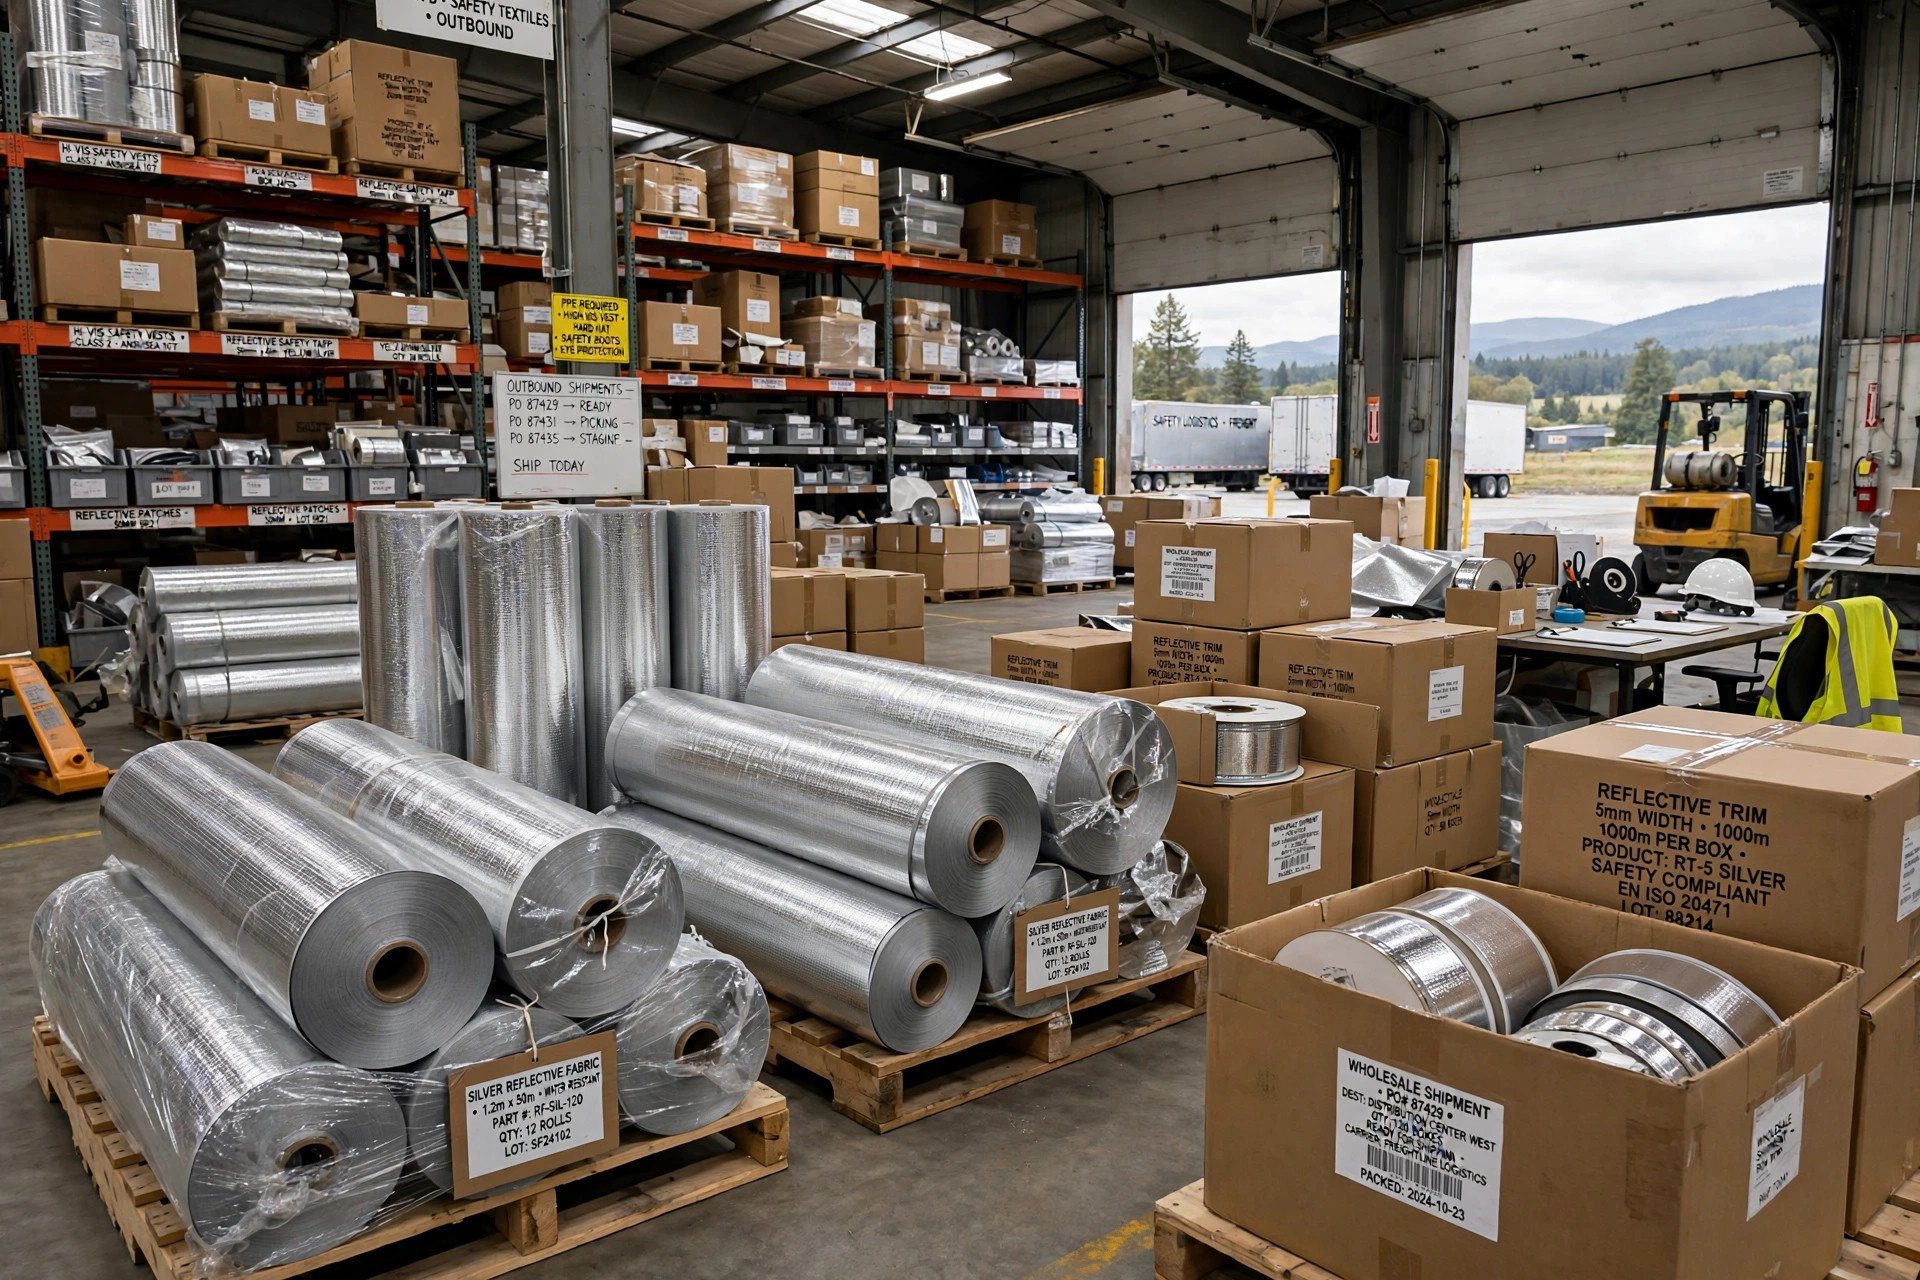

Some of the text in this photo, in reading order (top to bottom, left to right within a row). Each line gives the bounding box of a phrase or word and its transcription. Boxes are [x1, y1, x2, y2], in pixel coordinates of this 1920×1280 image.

[437, 12, 513, 39] OUTBOUND
[450, 0, 548, 27] SAFETY TEXTILES
[93, 147, 127, 159] SAFETY
[562, 298, 577, 308] PPE
[74, 338, 104, 347] CLASS
[87, 328, 104, 337] VIS
[226, 335, 277, 346] REFLECTIVE
[279, 338, 310, 347] SAFETY
[562, 334, 591, 344] SAFETY
[560, 346, 624, 356] EYE PROTECTION
[507, 379, 622, 395] OUTBOUND SHIPMENTS
[509, 398, 612, 412] PO 87429 READY
[510, 415, 618, 428] PO 87431 PICKING
[510, 432, 522, 444] PO
[528, 432, 560, 444] 87435
[513, 458, 585, 472] SHIP TODAY
[75, 508, 181, 520] REFLECTIVE PATCHES
[251, 505, 340, 515] REFLECTIVE PATCHES
[1154, 636, 1223, 653] REFLECTIVE TRIM
[1289, 664, 1353, 680] REFLECTIVE TRIM
[1598, 783, 1767, 825] REFLECTIVE TRIM
[1595, 802, 1769, 847] 5mm WIDTH 1000m
[1599, 823, 1734, 861] 1000m PER BOX
[1582, 836, 1786, 890] PRODUCT: RT-5 SILVER
[1591, 857, 1771, 907] SAFETY COMPLIANT
[1618, 881, 1730, 918] EN ISO 20471
[468, 1057, 600, 1102] SILVER REFLECTIVE FABRIC
[1348, 1058, 1490, 1120] WHOLESALE SHIPMENT
[482, 1102, 505, 1116] 1.2m
[508, 1100, 513, 1108] x
[516, 1092, 535, 1105] 50m
[492, 1112, 519, 1129] PART
[534, 1094, 583, 1116] RF-SIL-120
[1386, 1088, 1443, 1120] PO# 87429
[499, 1112, 572, 1143] QTY: 12 ROLLS
[1342, 1087, 1366, 1105] DEST:
[1430, 1120, 1466, 1141] CENTER
[1470, 1134, 1497, 1152] WEST
[504, 1128, 571, 1158] LOT: SF24102
[1440, 1160, 1487, 1186] LOGISTICS
[1360, 1168, 1465, 1221] PACKED: 2024-10-23
